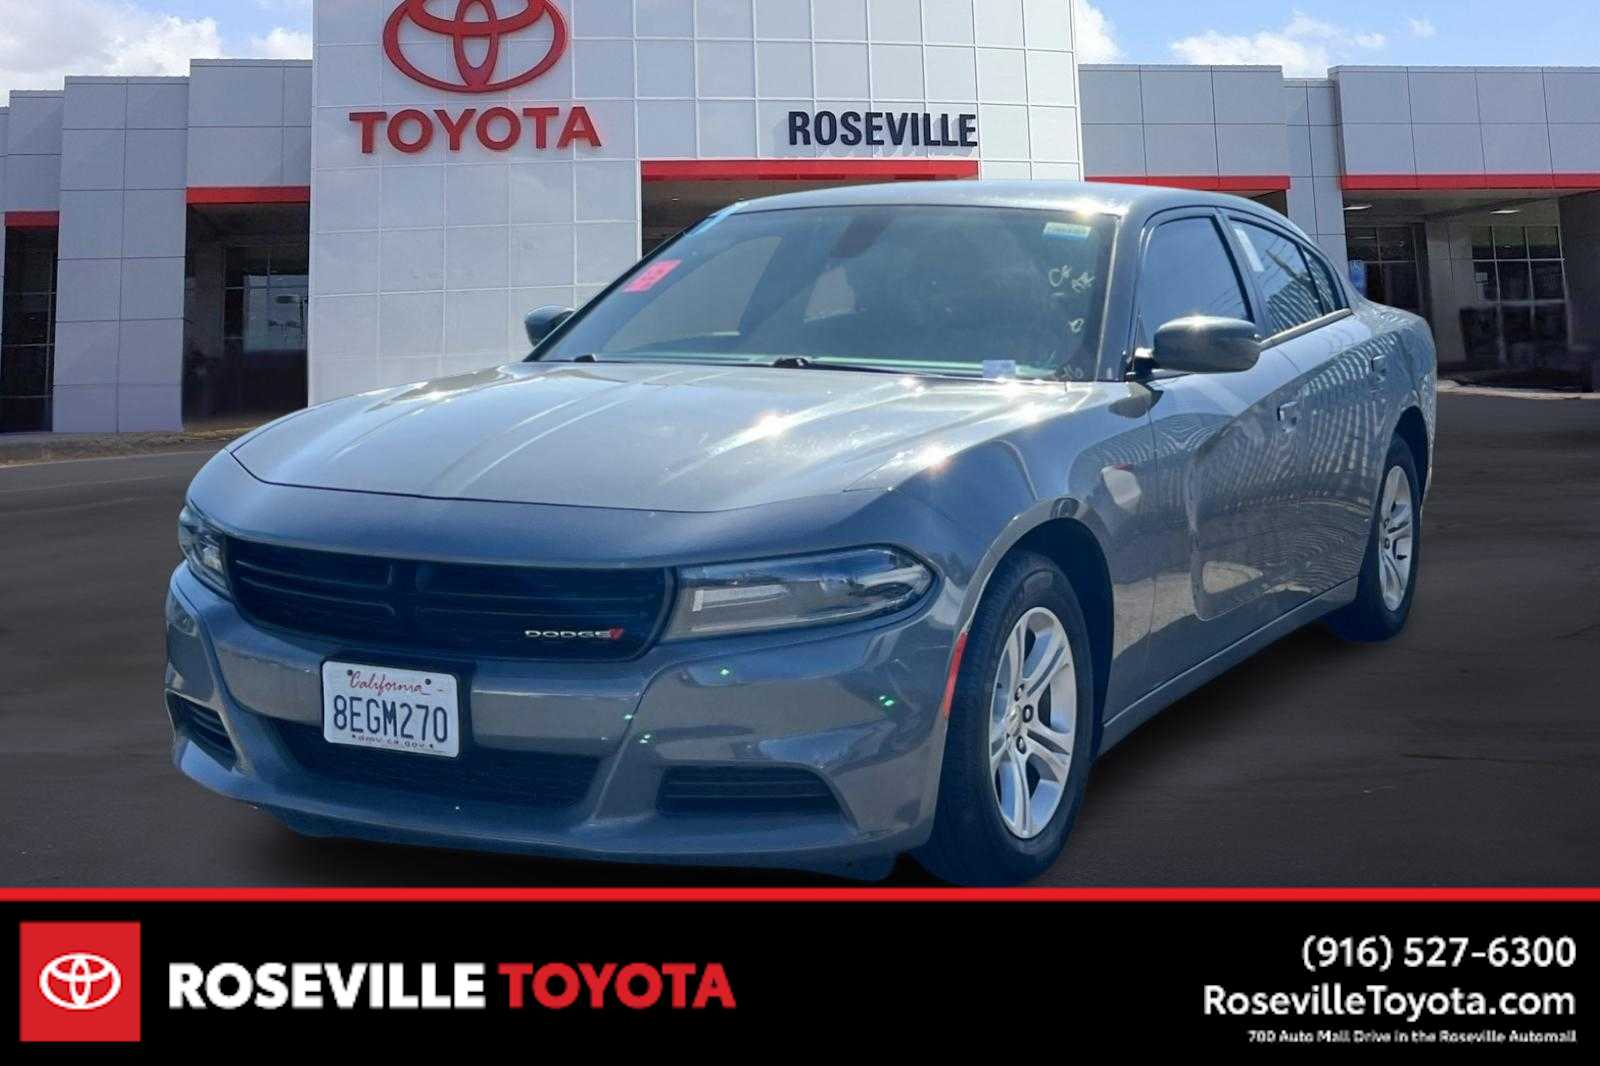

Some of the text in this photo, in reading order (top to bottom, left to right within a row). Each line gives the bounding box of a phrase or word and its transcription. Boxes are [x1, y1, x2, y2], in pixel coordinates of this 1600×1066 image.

[349, 106, 602, 154] TOYOTA
[788, 111, 978, 147] ROSEVILLE
[524, 630, 611, 639] DODGE
[349, 670, 423, 697] California
[333, 694, 448, 744] 8EGM270
